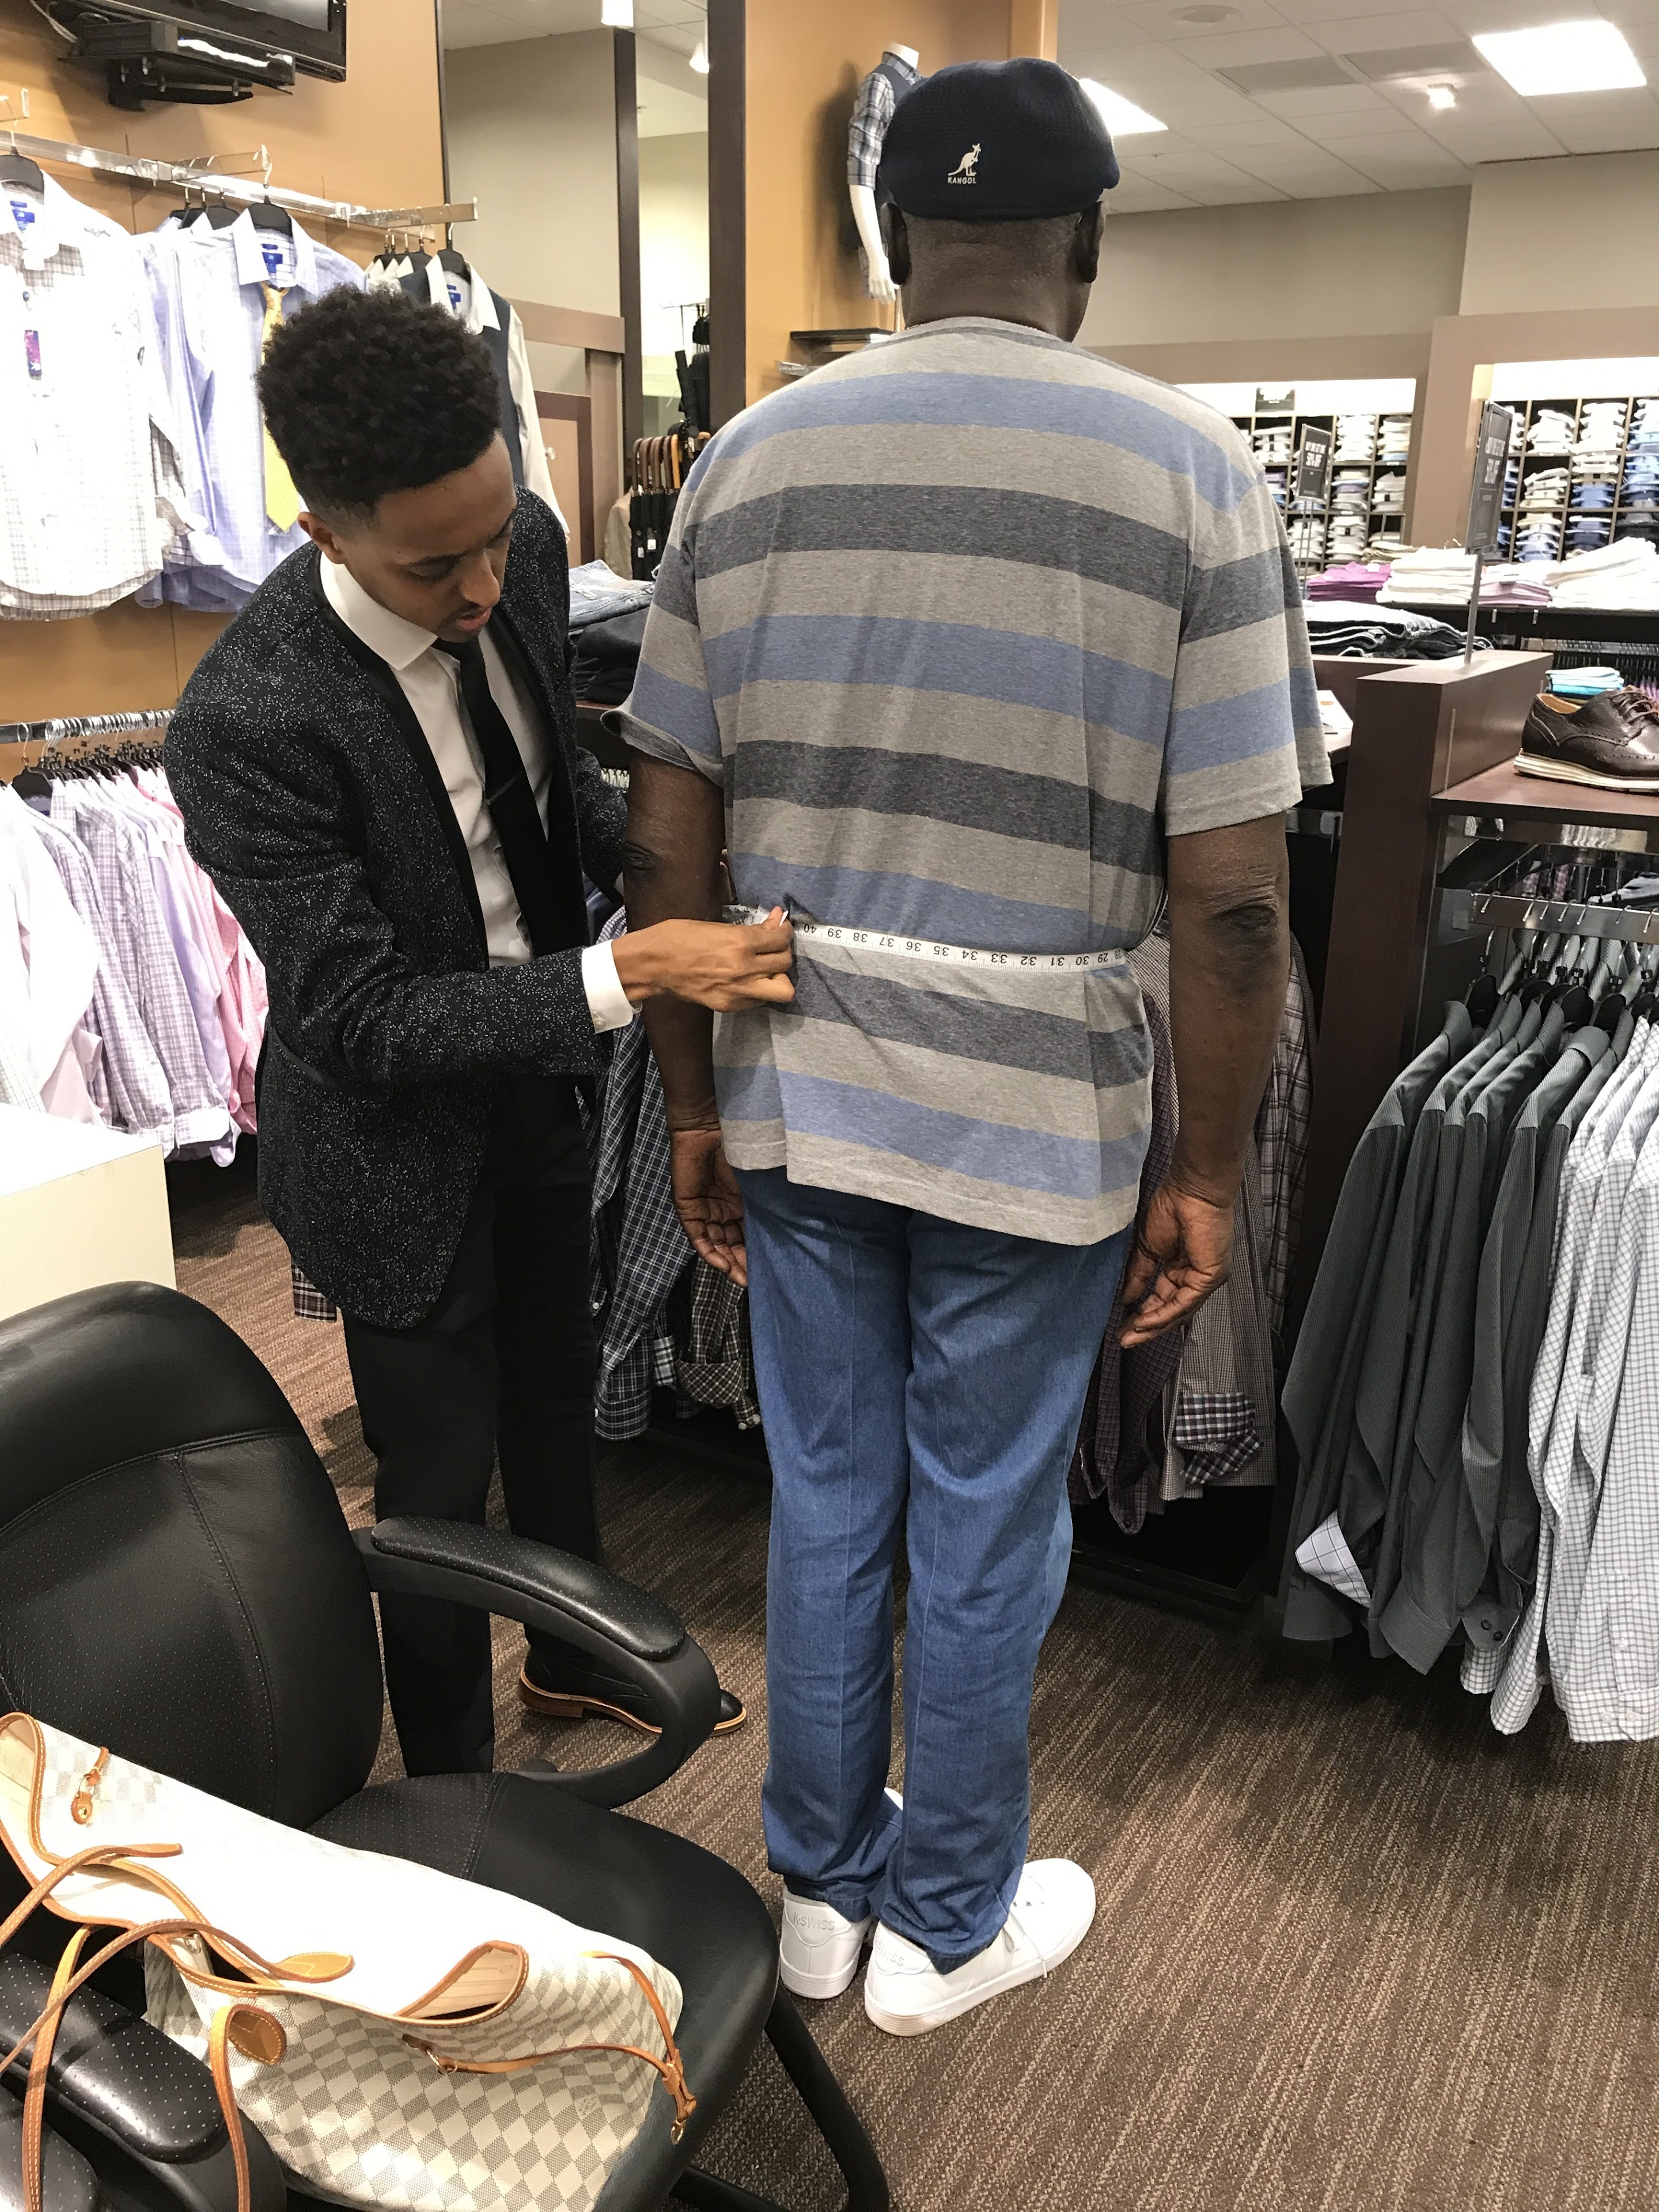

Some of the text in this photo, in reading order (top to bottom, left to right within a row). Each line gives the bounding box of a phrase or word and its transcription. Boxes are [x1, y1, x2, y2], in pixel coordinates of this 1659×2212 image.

[804, 923, 817, 934] 40
[827, 927, 842, 938] 39
[853, 932, 868, 943] 38
[879, 937, 895, 948] 37
[906, 941, 922, 952] 36
[934, 945, 949, 956] 35
[962, 950, 978, 961] 34
[991, 953, 1008, 964] 33
[1021, 956, 1037, 966] 32
[1076, 956, 1089, 965] 30
[1098, 953, 1108, 963] 29
[1051, 957, 1065, 966] 31
